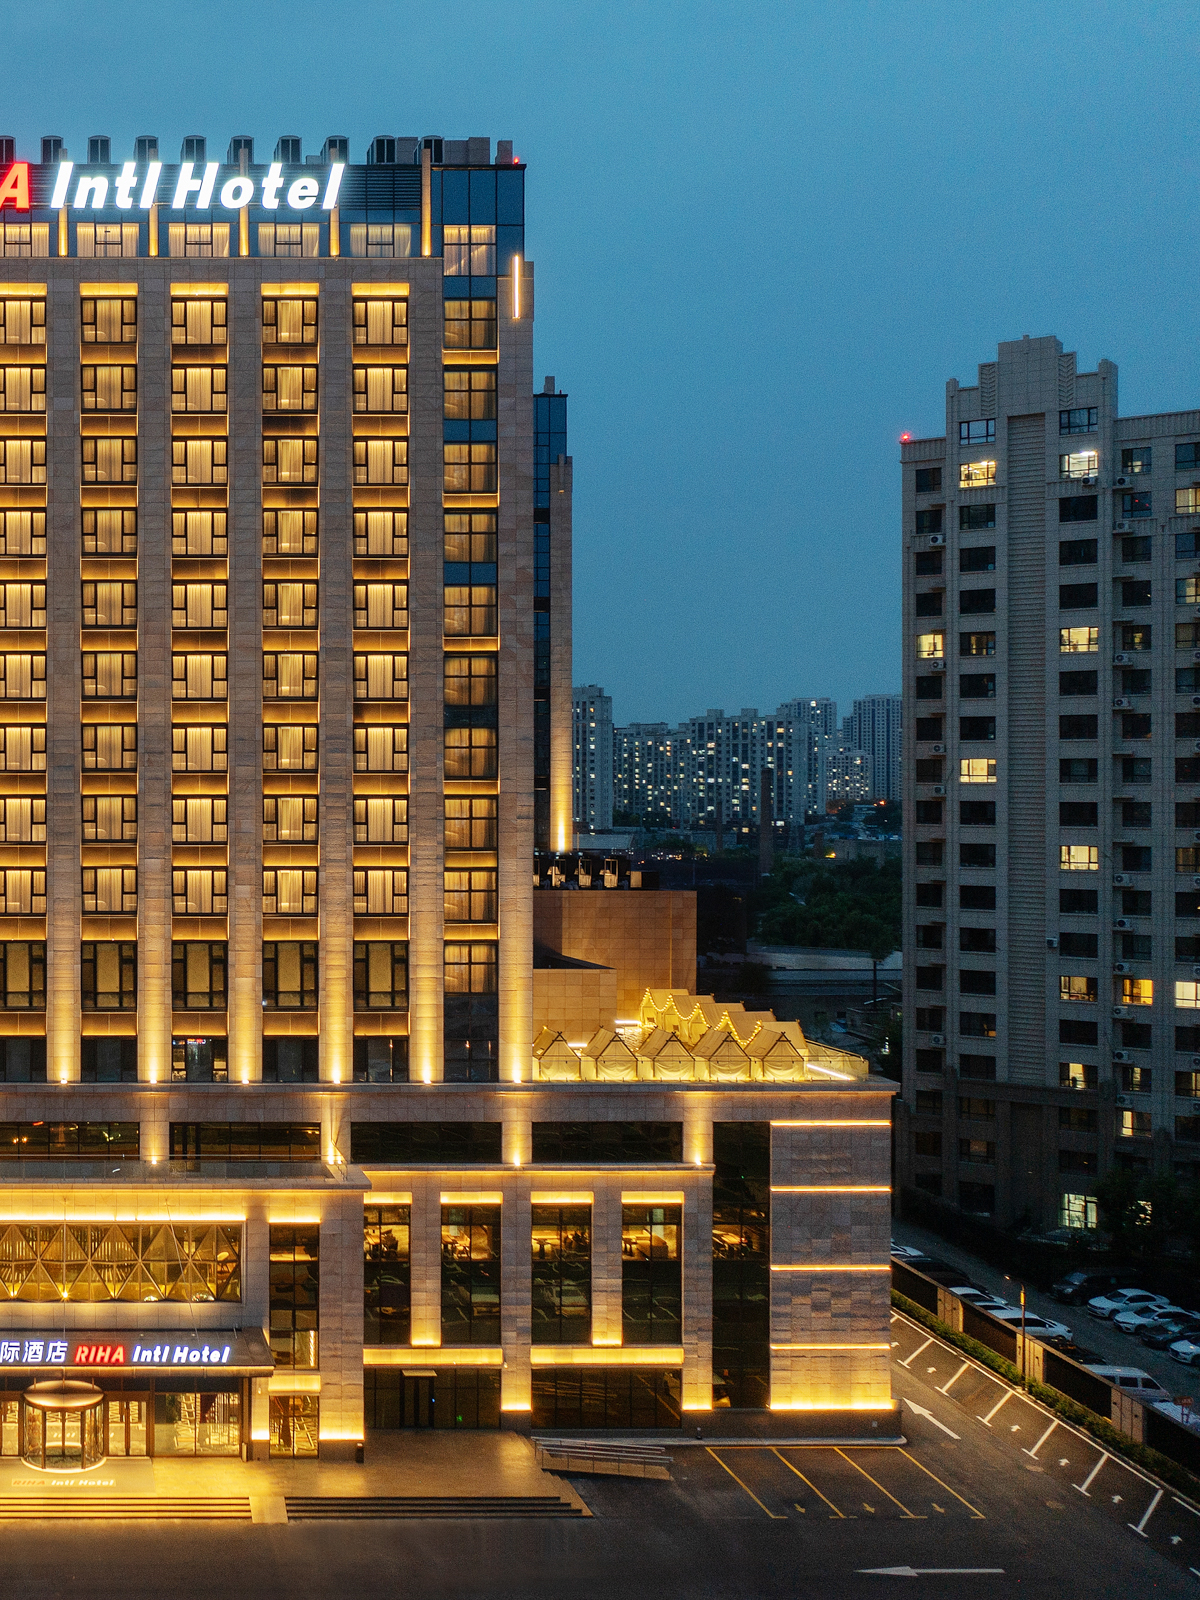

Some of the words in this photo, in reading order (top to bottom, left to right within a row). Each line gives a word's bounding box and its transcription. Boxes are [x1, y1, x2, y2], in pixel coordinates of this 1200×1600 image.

[50, 160, 163, 210] Intl
[171, 161, 346, 210] Hotel
[74, 1345, 125, 1363] RIHA
[132, 1345, 170, 1363] Intl
[173, 1345, 230, 1364] Hotel
